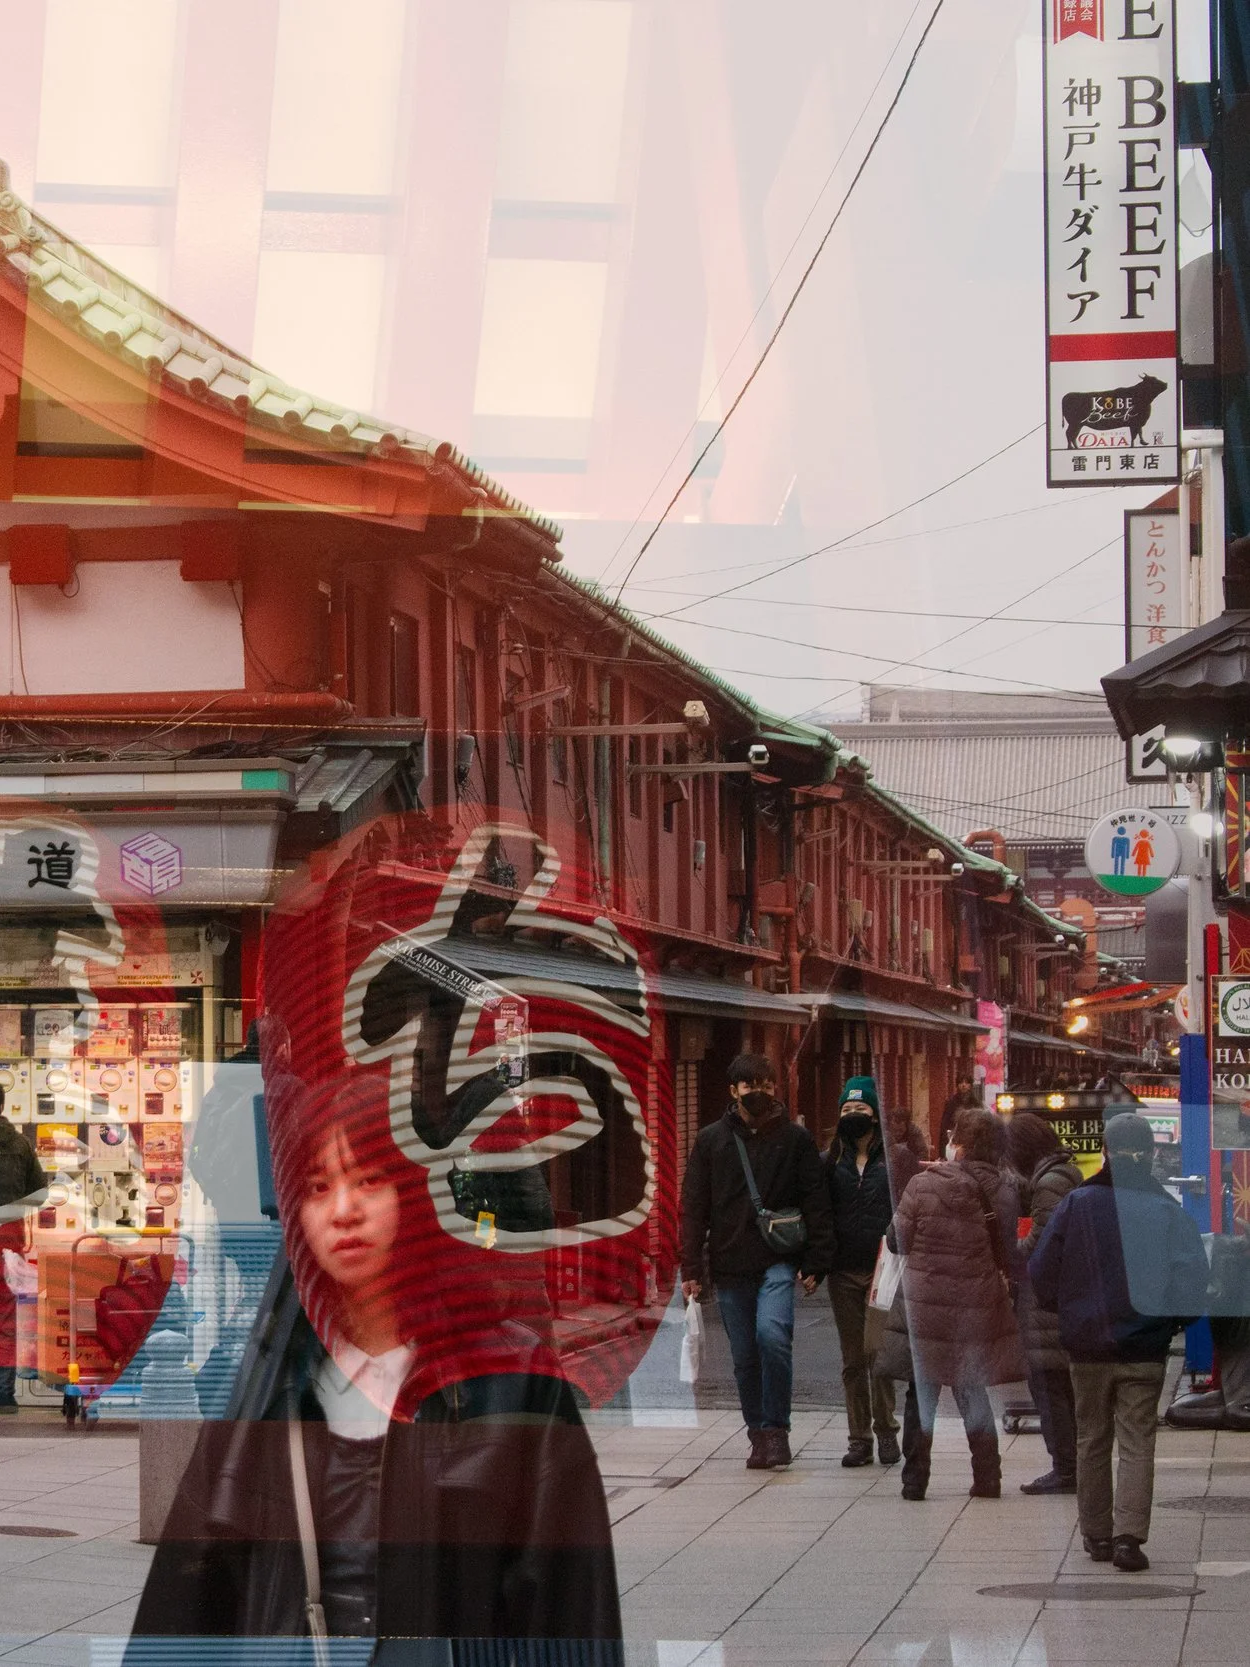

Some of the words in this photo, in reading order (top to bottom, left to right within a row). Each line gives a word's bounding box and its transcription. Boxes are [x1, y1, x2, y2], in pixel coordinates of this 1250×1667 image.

[1062, 78, 1102, 324] 神戸牛ダイア
[1117, 75, 1167, 321] BEEF
[1071, 453, 1161, 472] 雷門東店
[1077, 432, 1130, 448] DAIA
[1146, 520, 1167, 595] とんかつ
[1146, 603, 1167, 645] 洋食
